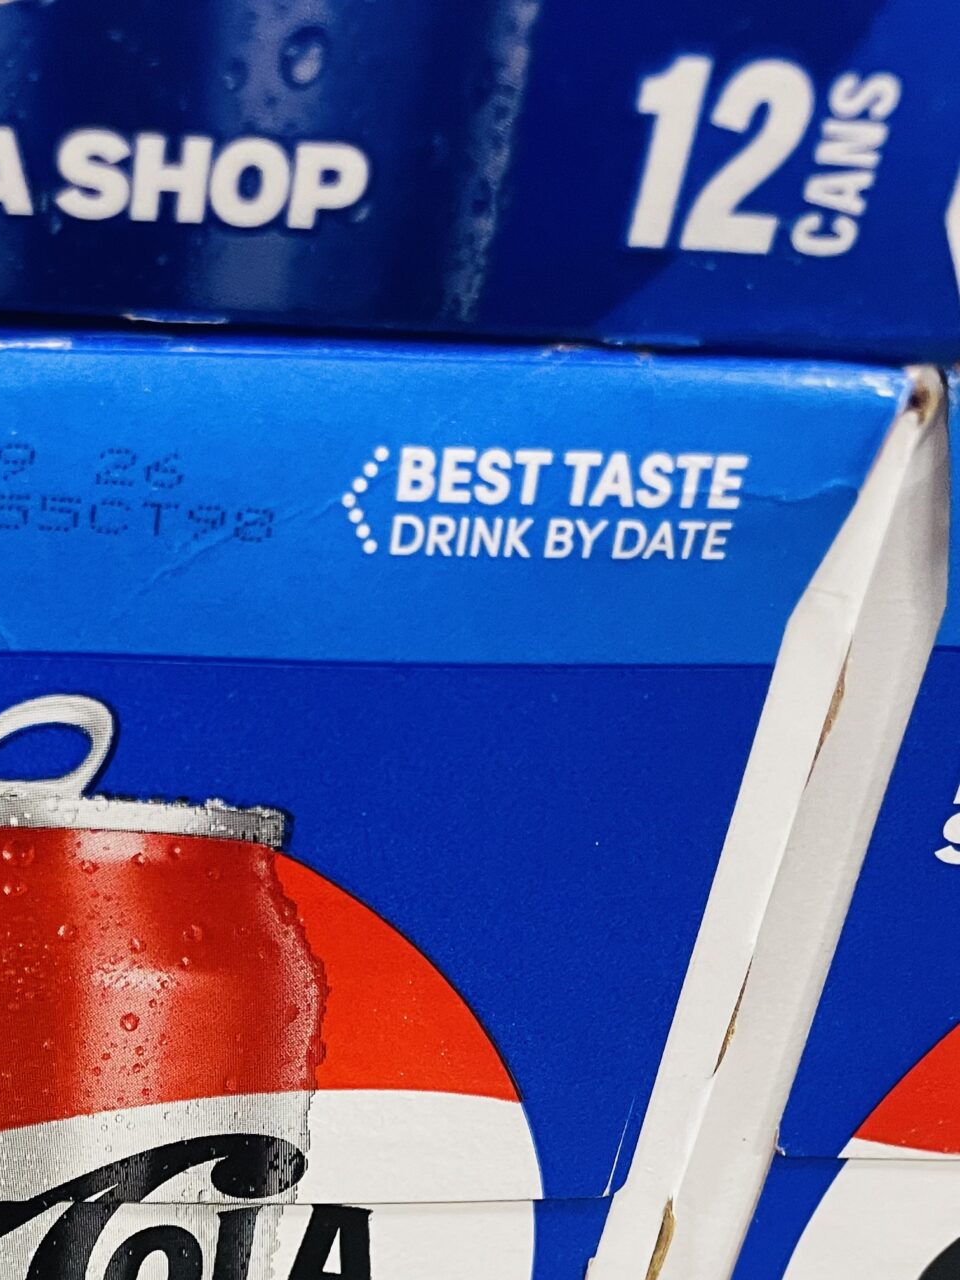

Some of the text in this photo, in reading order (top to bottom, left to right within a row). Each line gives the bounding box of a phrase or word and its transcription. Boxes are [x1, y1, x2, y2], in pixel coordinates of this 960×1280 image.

[56, 127, 369, 230] SHOP
[627, 53, 815, 256] 12
[791, 71, 902, 257] CANS
[95, 448, 185, 489] 26
[395, 446, 749, 510] BEST TASTE
[388, 513, 733, 560] DRINK BY DATE
